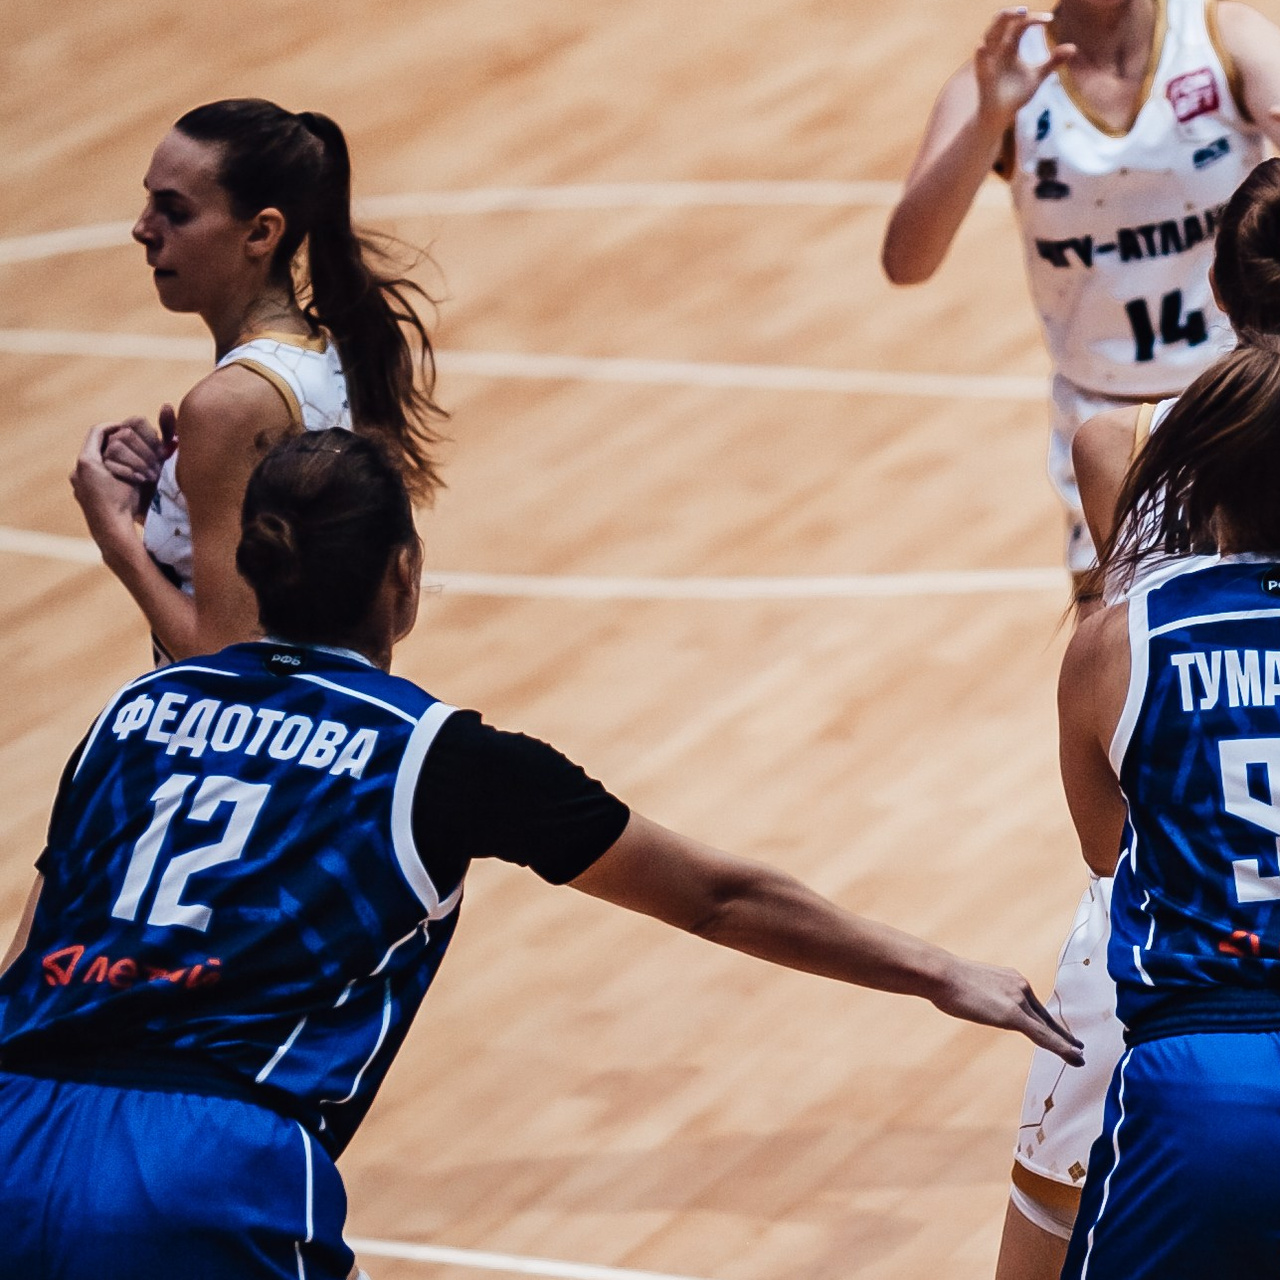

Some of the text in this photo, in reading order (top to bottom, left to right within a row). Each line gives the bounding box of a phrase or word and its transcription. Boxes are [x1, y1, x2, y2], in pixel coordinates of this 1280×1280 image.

[1125, 289, 1208, 362] 14
[112, 691, 380, 780] ФЕДОТОВА
[111, 773, 273, 933] 12
